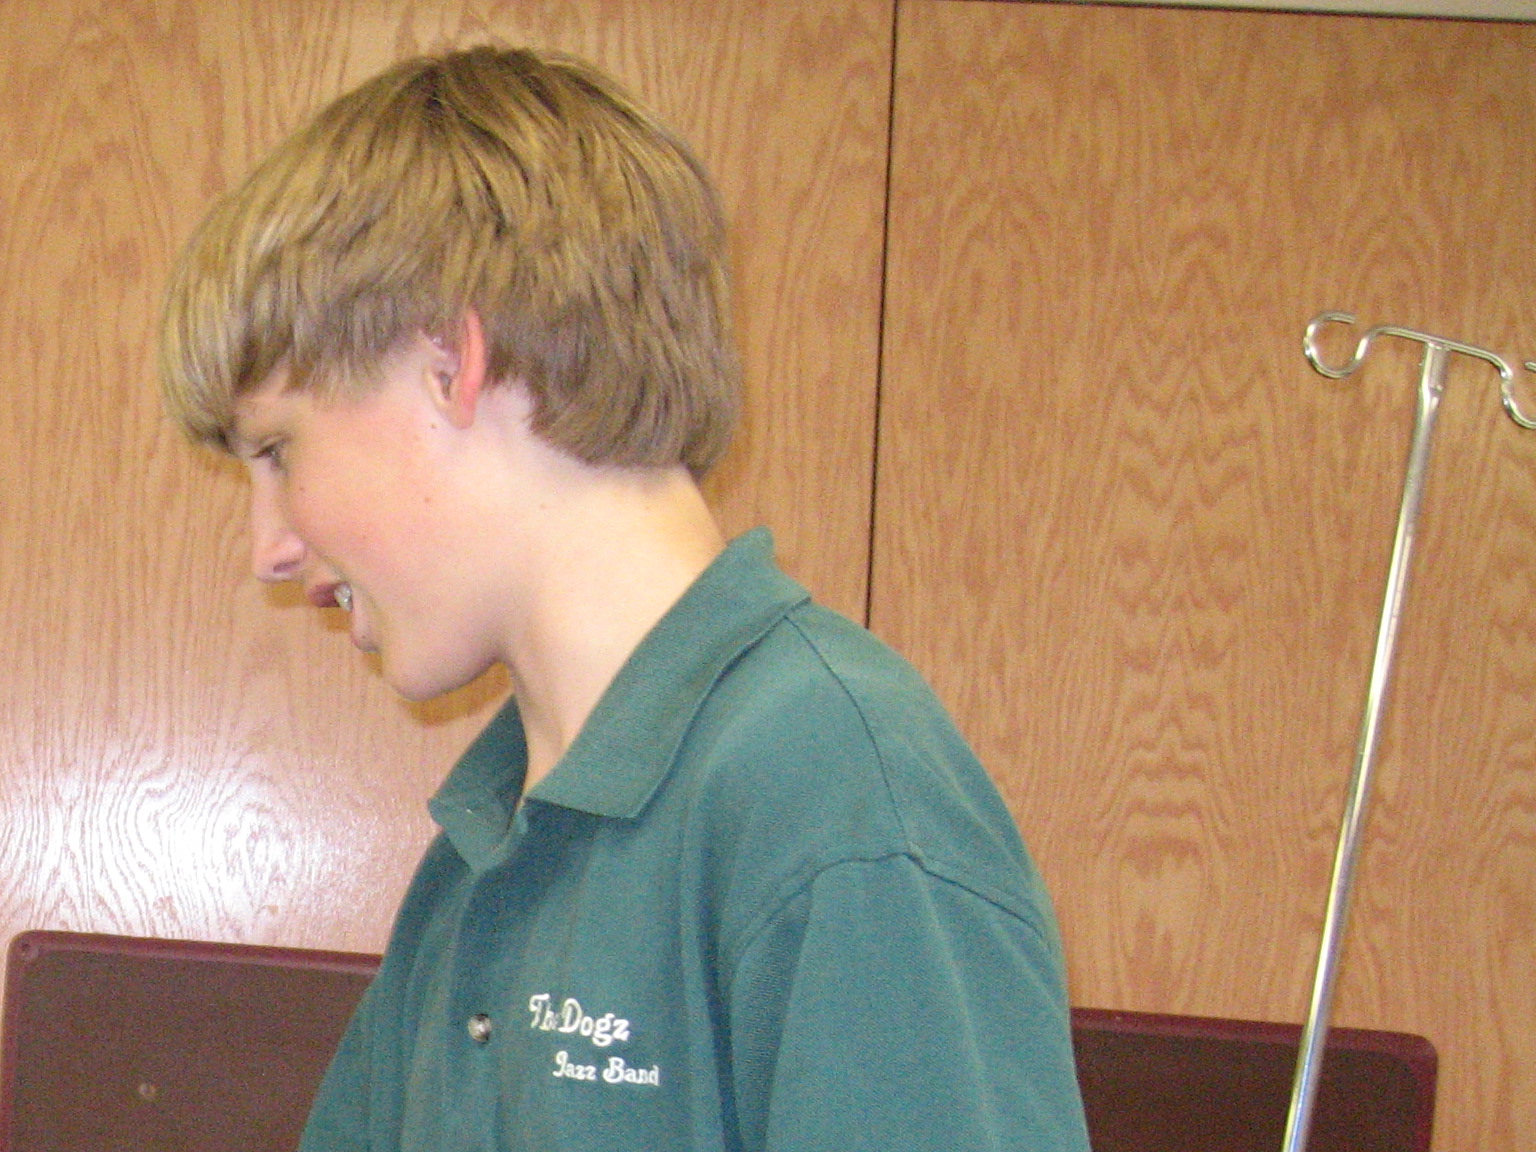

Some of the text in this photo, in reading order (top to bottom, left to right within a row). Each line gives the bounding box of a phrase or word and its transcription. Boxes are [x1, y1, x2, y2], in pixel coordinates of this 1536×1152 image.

[558, 998, 630, 1047] Dogz
[553, 1050, 660, 1086] Jazz Band
